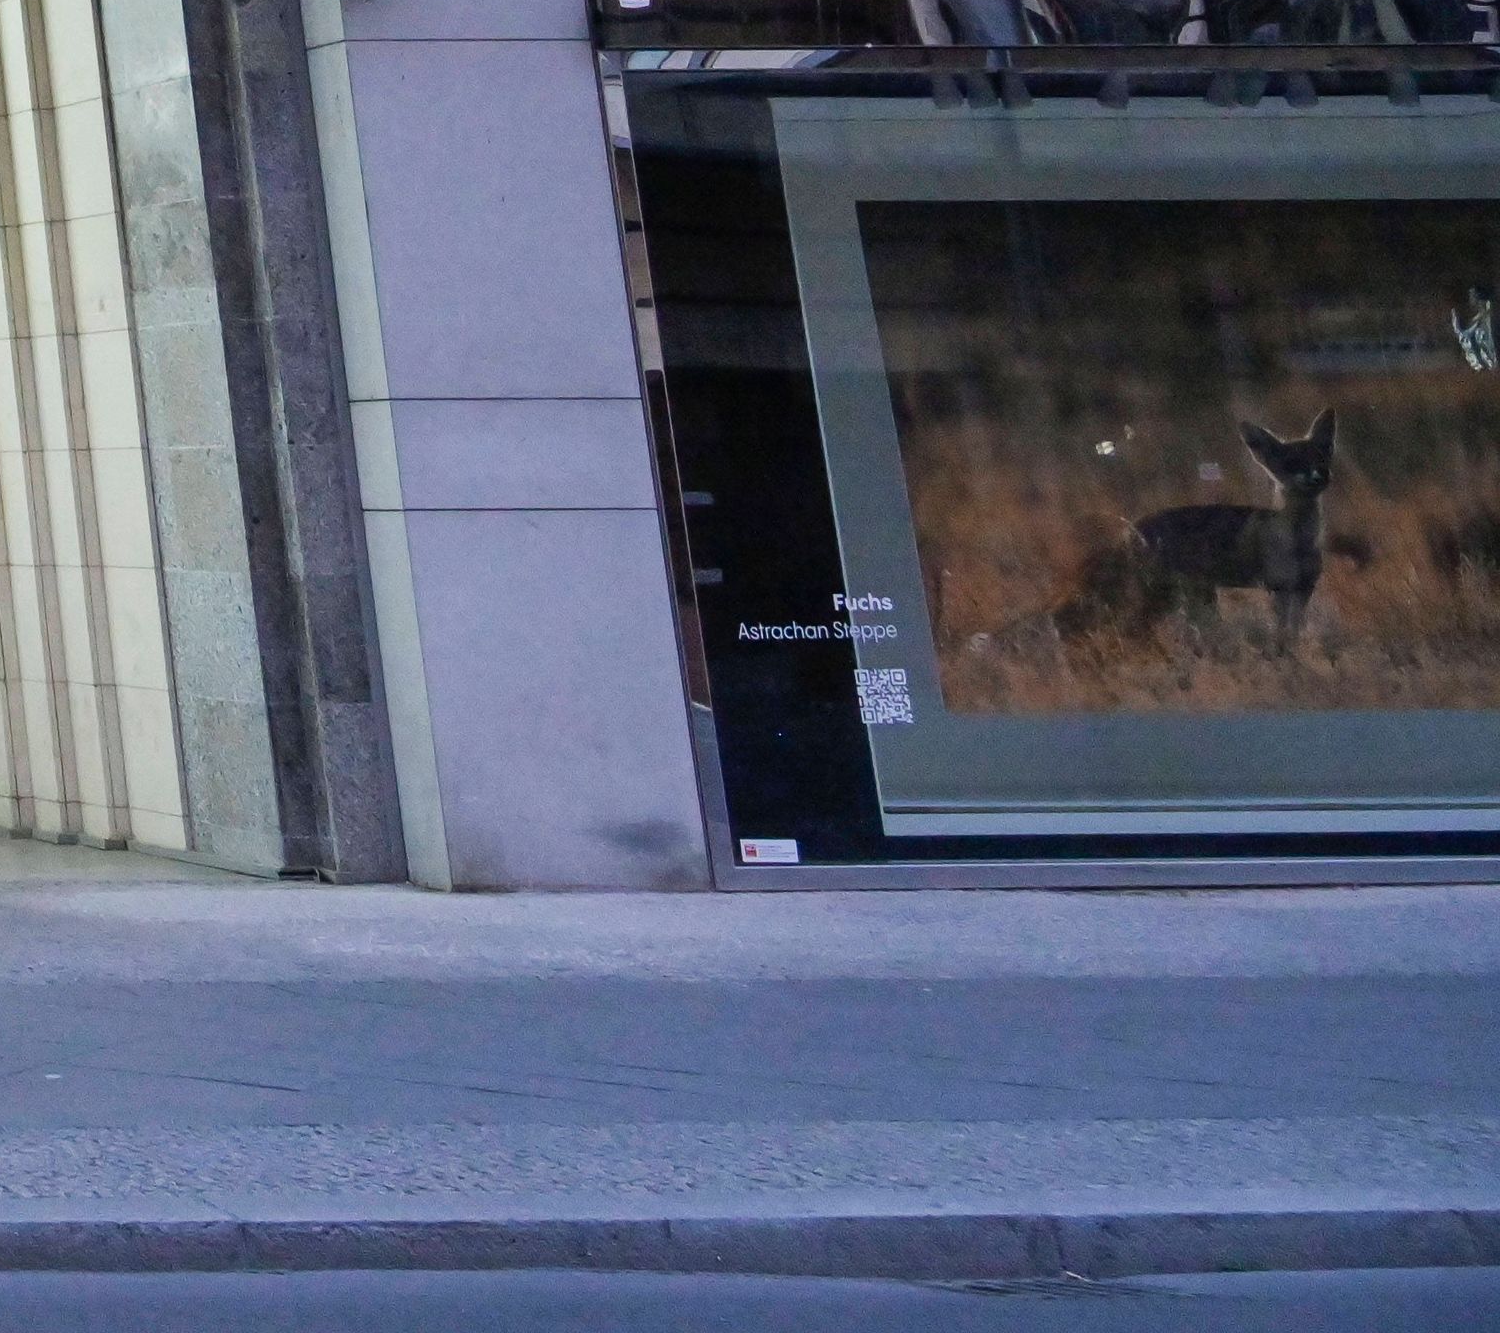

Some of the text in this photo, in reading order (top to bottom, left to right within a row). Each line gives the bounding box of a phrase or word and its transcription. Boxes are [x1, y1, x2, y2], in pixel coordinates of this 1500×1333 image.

[832, 593, 893, 611] Fuchs
[738, 620, 898, 644] Astrachan Steppe
